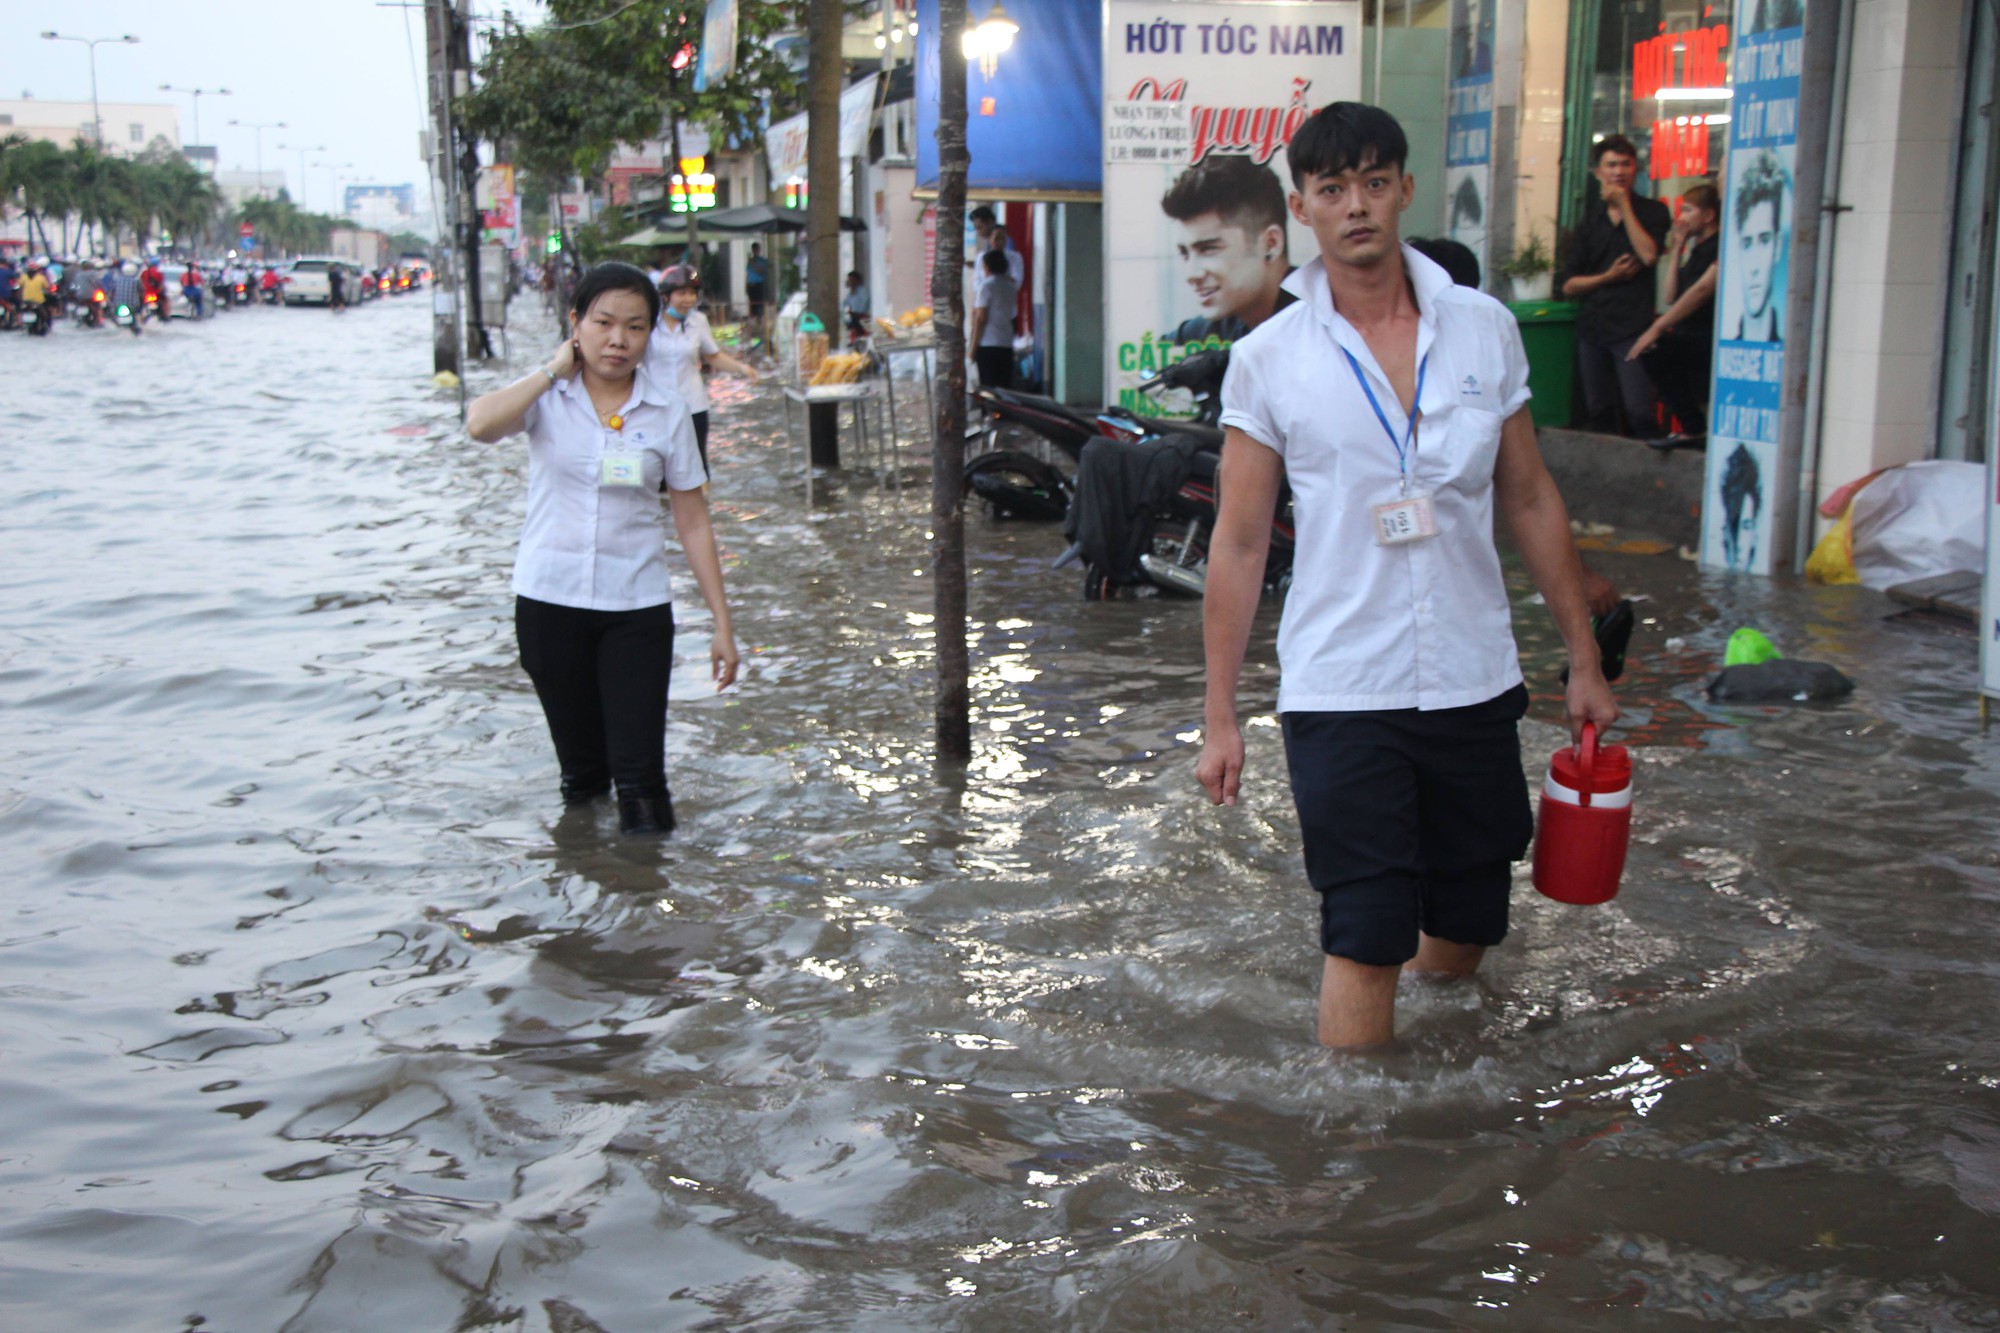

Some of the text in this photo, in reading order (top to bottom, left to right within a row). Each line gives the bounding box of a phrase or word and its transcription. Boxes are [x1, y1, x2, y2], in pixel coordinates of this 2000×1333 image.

[1126, 17, 1344, 55] HỚT TÓC NAM
